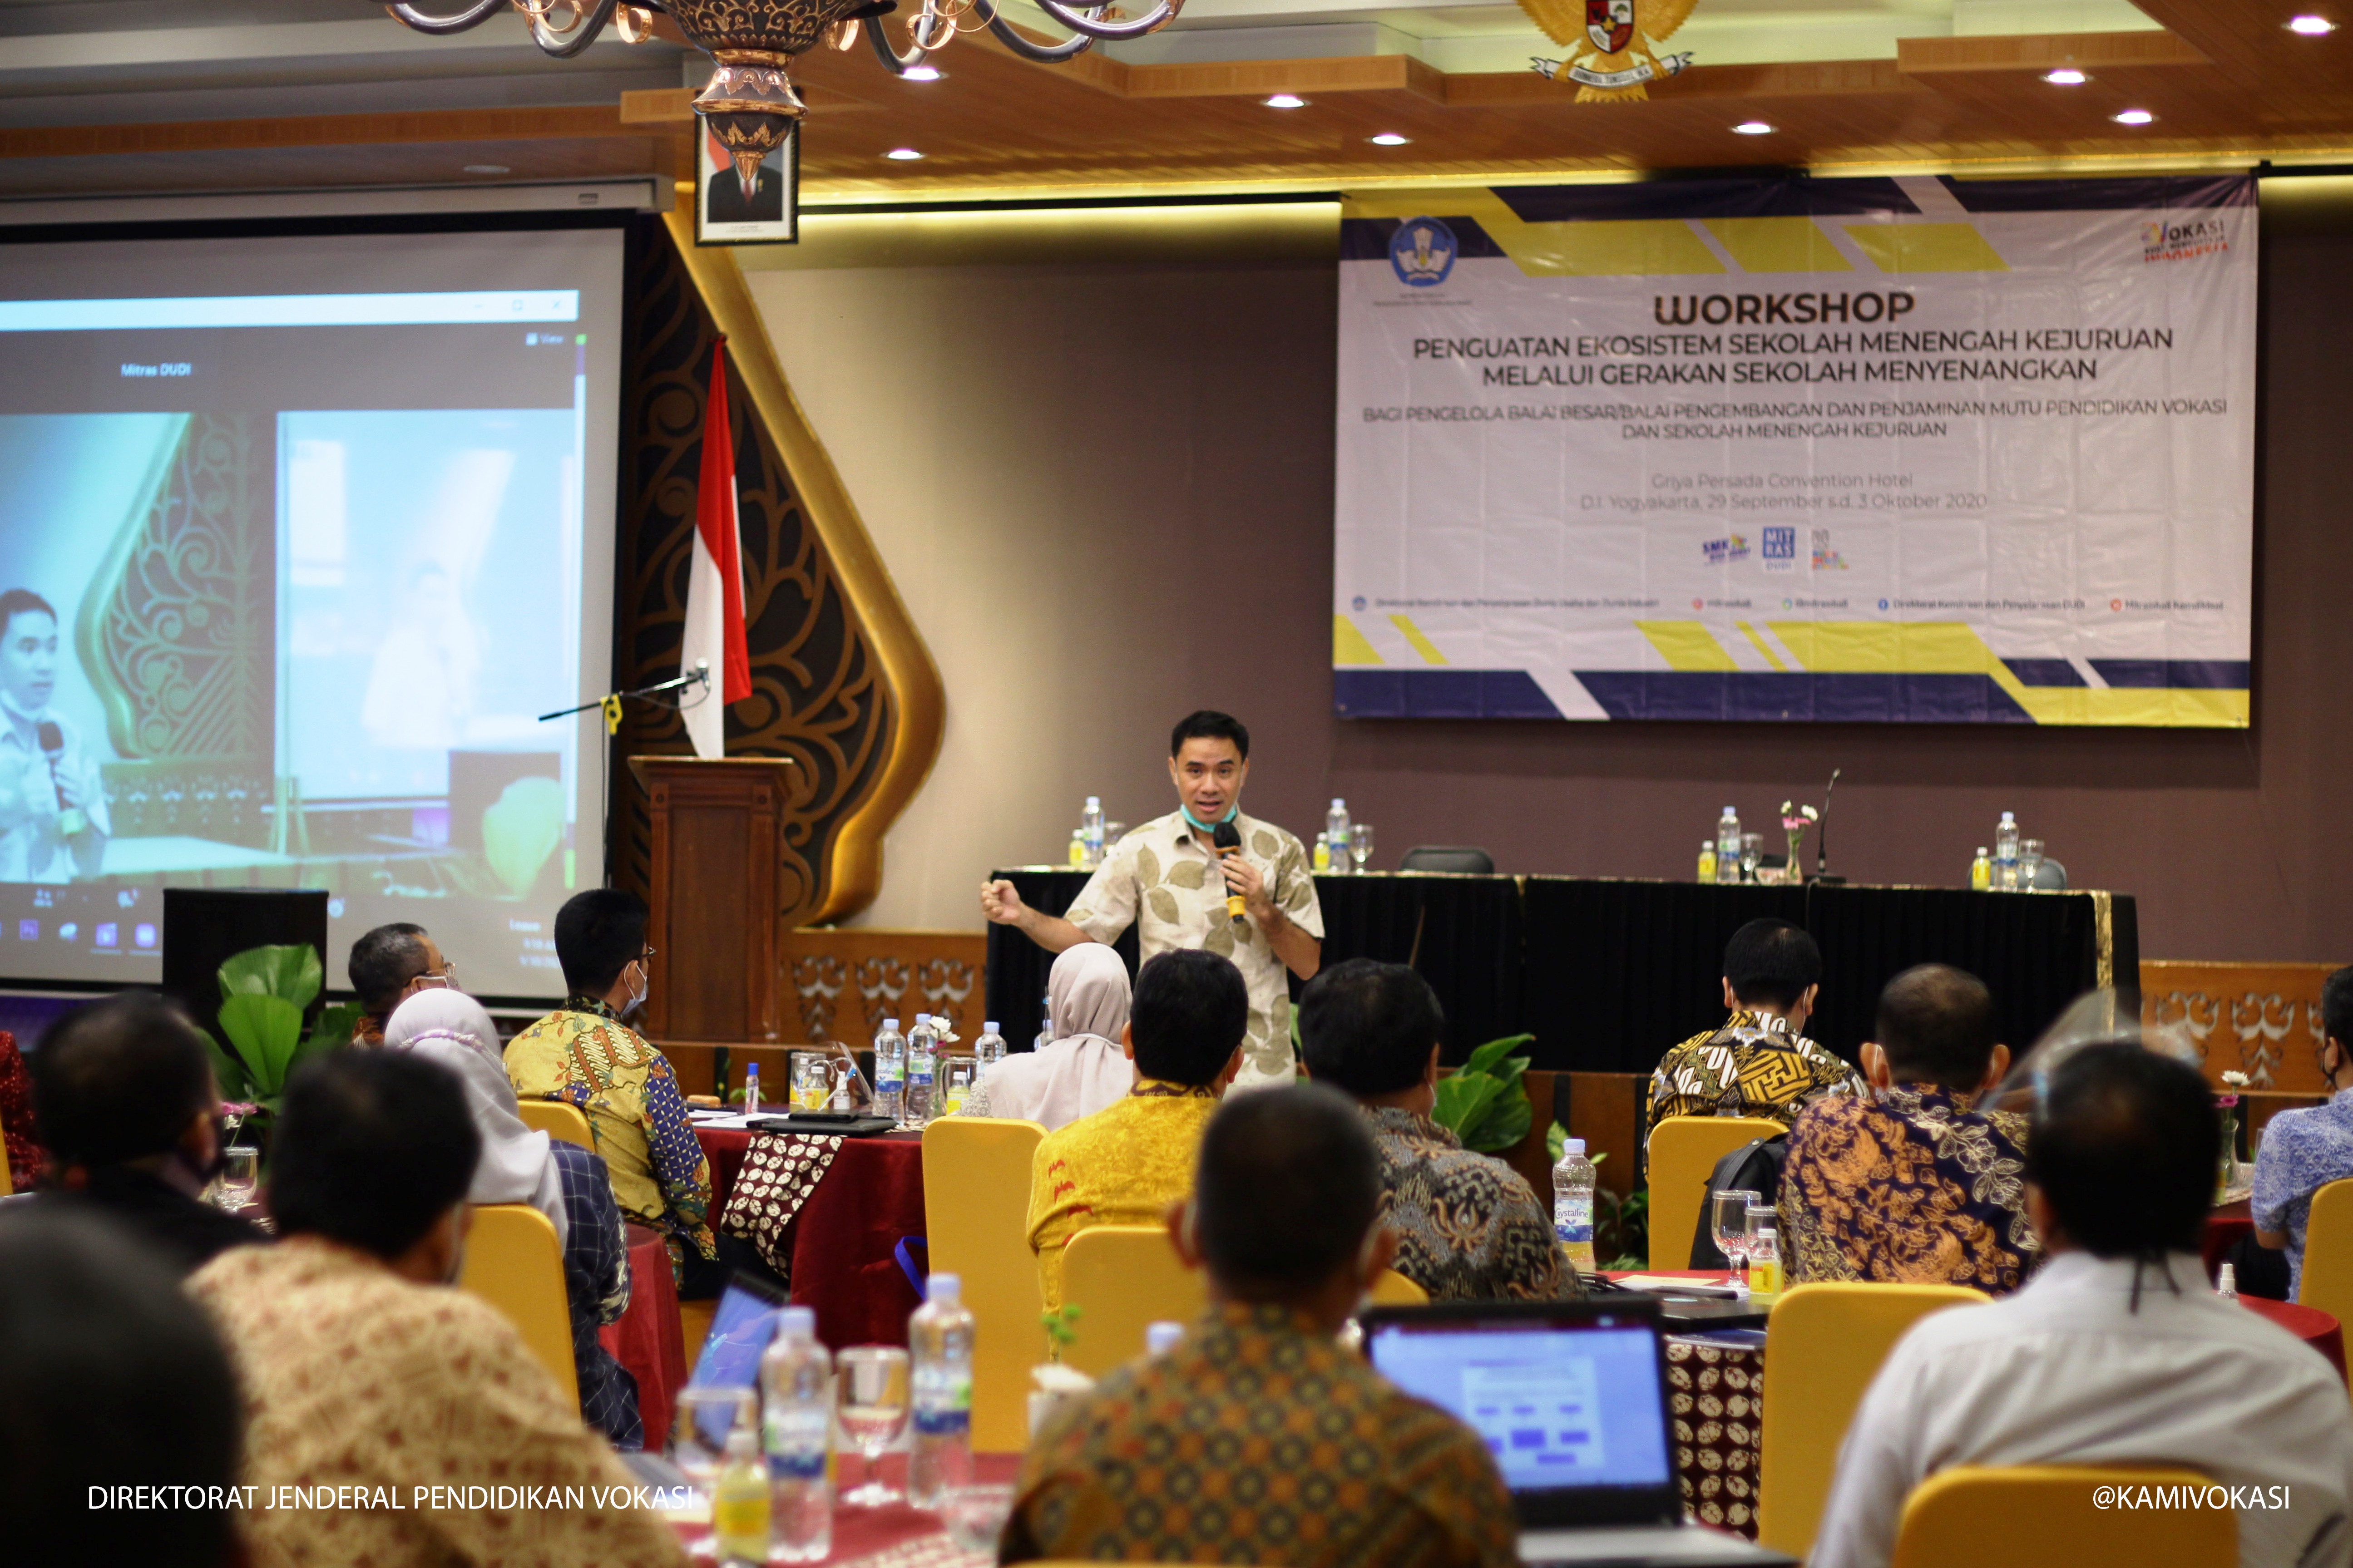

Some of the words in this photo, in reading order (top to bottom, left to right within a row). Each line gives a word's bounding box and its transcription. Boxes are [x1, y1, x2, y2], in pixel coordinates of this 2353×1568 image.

[1655, 291, 1914, 325] WORKSHOP
[1414, 337, 1570, 359] PENGUATAN
[1577, 334, 1722, 357] EKOSISTEM
[1729, 333, 1852, 355] SEKOLAH
[1860, 330, 2017, 353] MENENGAH
[2026, 328, 2173, 351] KEJURUAN
[1483, 365, 1593, 386] MELALUI
[1600, 363, 1725, 385] GERAKAN
[1733, 361, 1857, 383] SEKOLAH
[1864, 359, 2096, 382] MENYENANGKAN
[1363, 407, 1402, 422] BAGI
[1406, 406, 1504, 421] PENGELOLA
[1508, 405, 1557, 420] BALAI
[1674, 402, 1823, 418] PENGEMBANGAN
[1827, 402, 1865, 417] DAN
[1869, 401, 1985, 417] PENJAMINAN
[1990, 400, 2041, 415] MUTU
[2046, 399, 2157, 415] PENDIDIKAN
[2162, 399, 2227, 415] VOKASI
[1622, 424, 1659, 439] DAN
[1663, 423, 1743, 439] SEKOLAH
[1747, 423, 1849, 438] MENENGAH
[1853, 422, 1947, 437] KEJURUAN
[1651, 473, 1693, 492] Griya
[1697, 473, 1764, 488] Persada
[1767, 473, 1864, 489] Convention
[1869, 473, 1913, 488] Hotel
[1766, 529, 1793, 542] MIT
